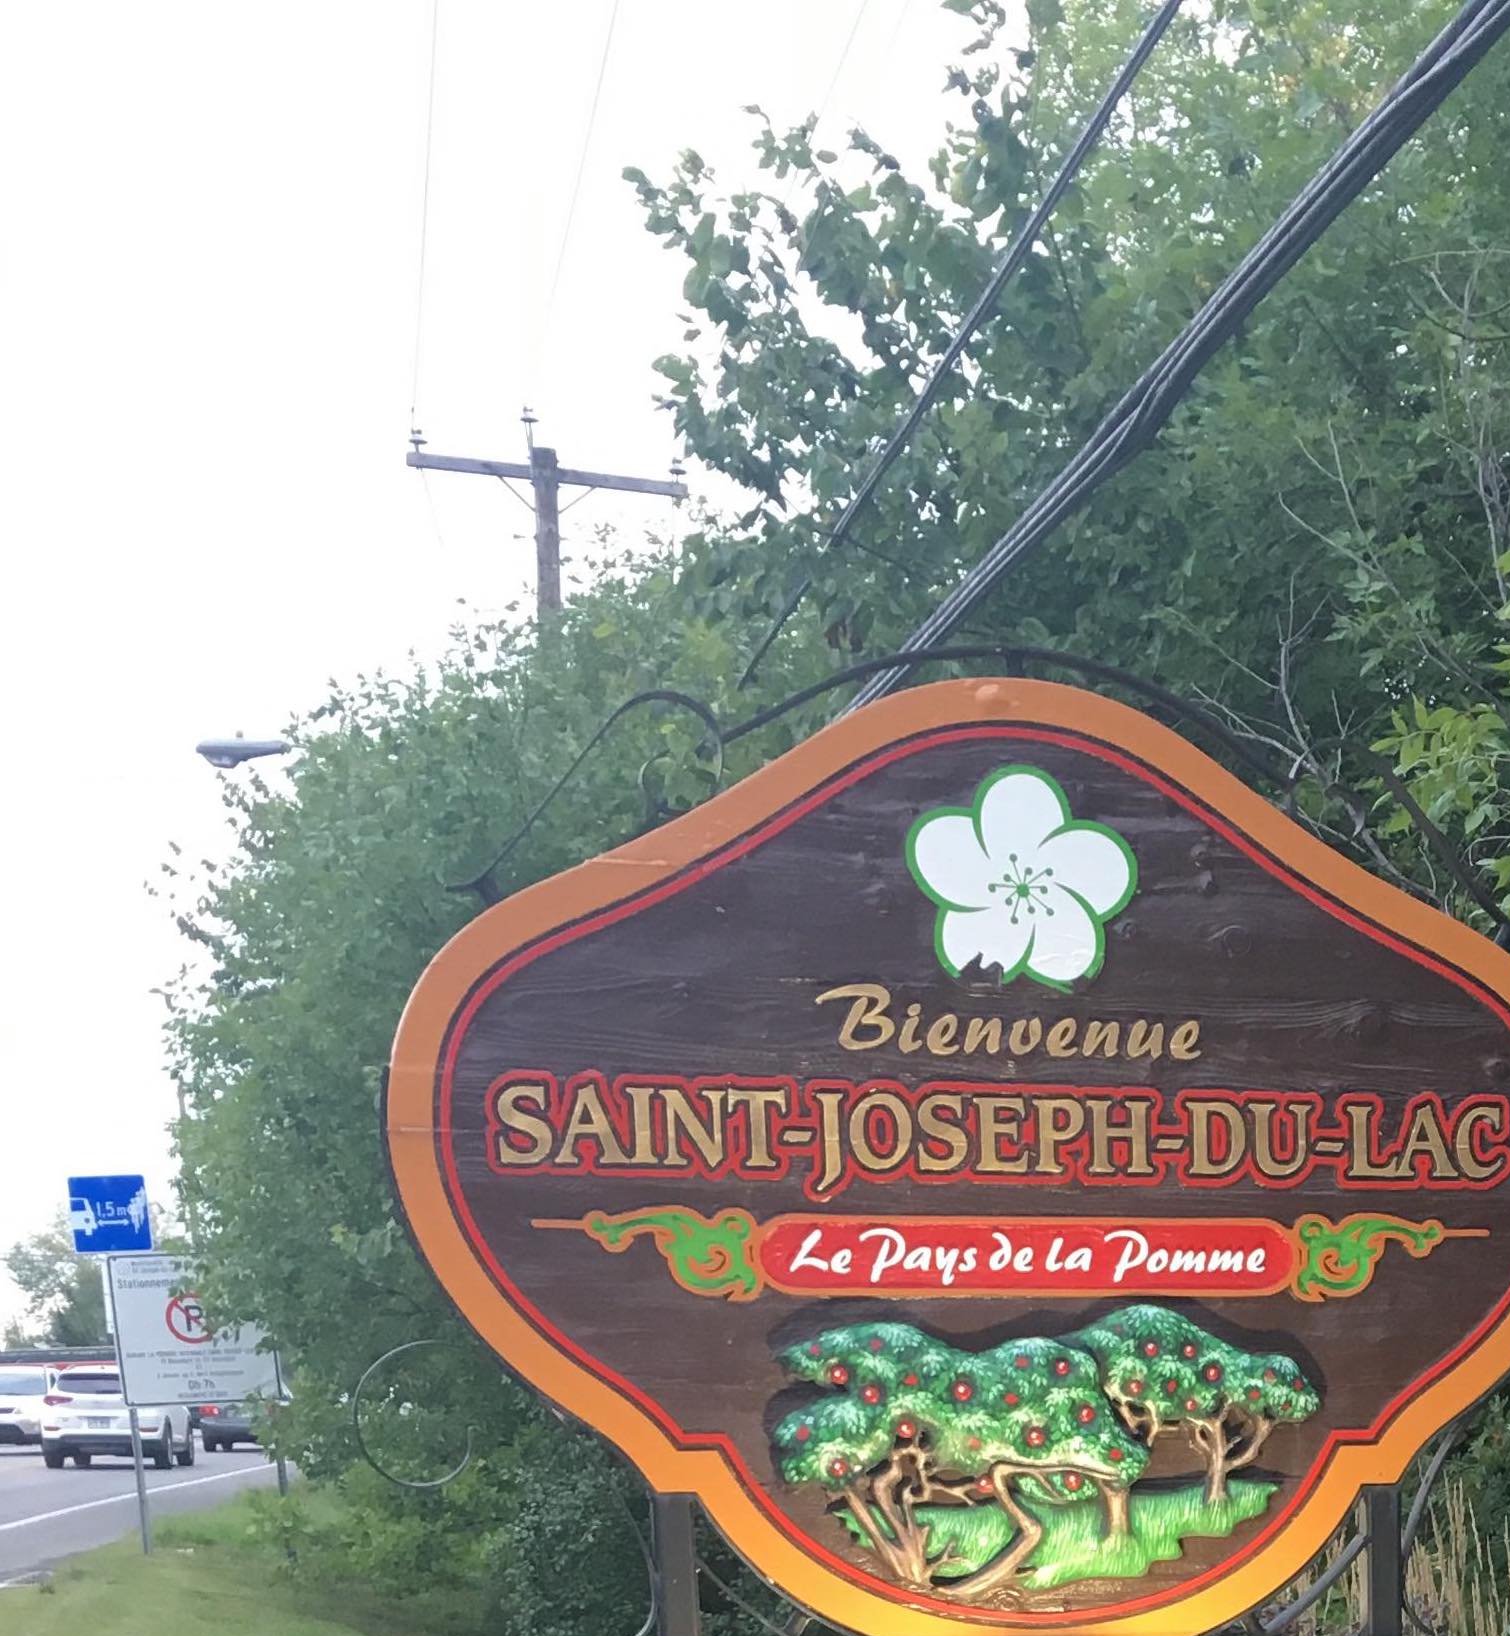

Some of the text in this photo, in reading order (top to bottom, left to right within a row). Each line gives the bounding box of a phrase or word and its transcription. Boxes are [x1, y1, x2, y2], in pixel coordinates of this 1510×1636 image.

[815, 983, 1203, 1060] Bienvenue
[496, 1083, 1504, 1192] SAINT-JOSEPH-DU-LAC
[789, 1227, 1267, 1286] Le Pays de la Pomme
